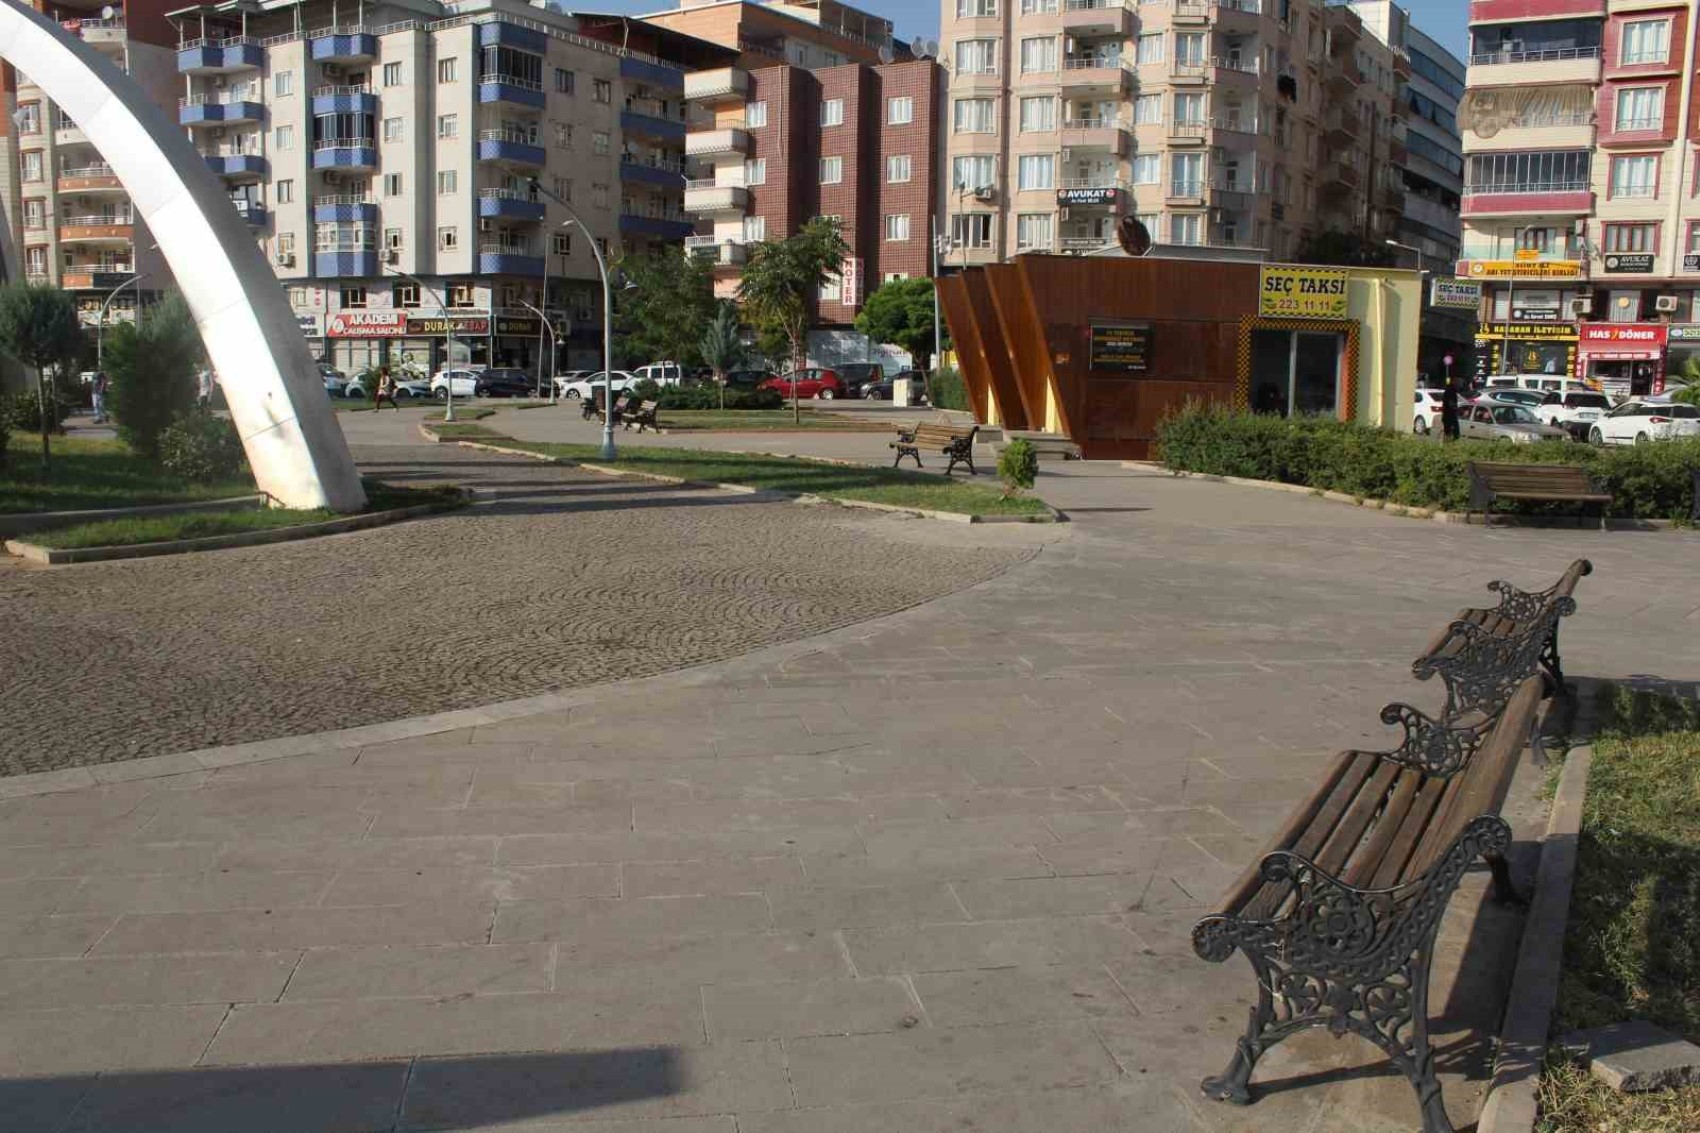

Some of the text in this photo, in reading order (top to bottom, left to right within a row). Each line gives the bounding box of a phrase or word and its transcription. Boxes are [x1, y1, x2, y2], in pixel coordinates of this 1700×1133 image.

[1068, 190, 1105, 198] AVUKAT
[1264, 275, 1346, 296] SEÇ TAKSİ
[1279, 299, 1330, 310] 223 11 11
[1589, 329, 1655, 339] HAS DÖNER
